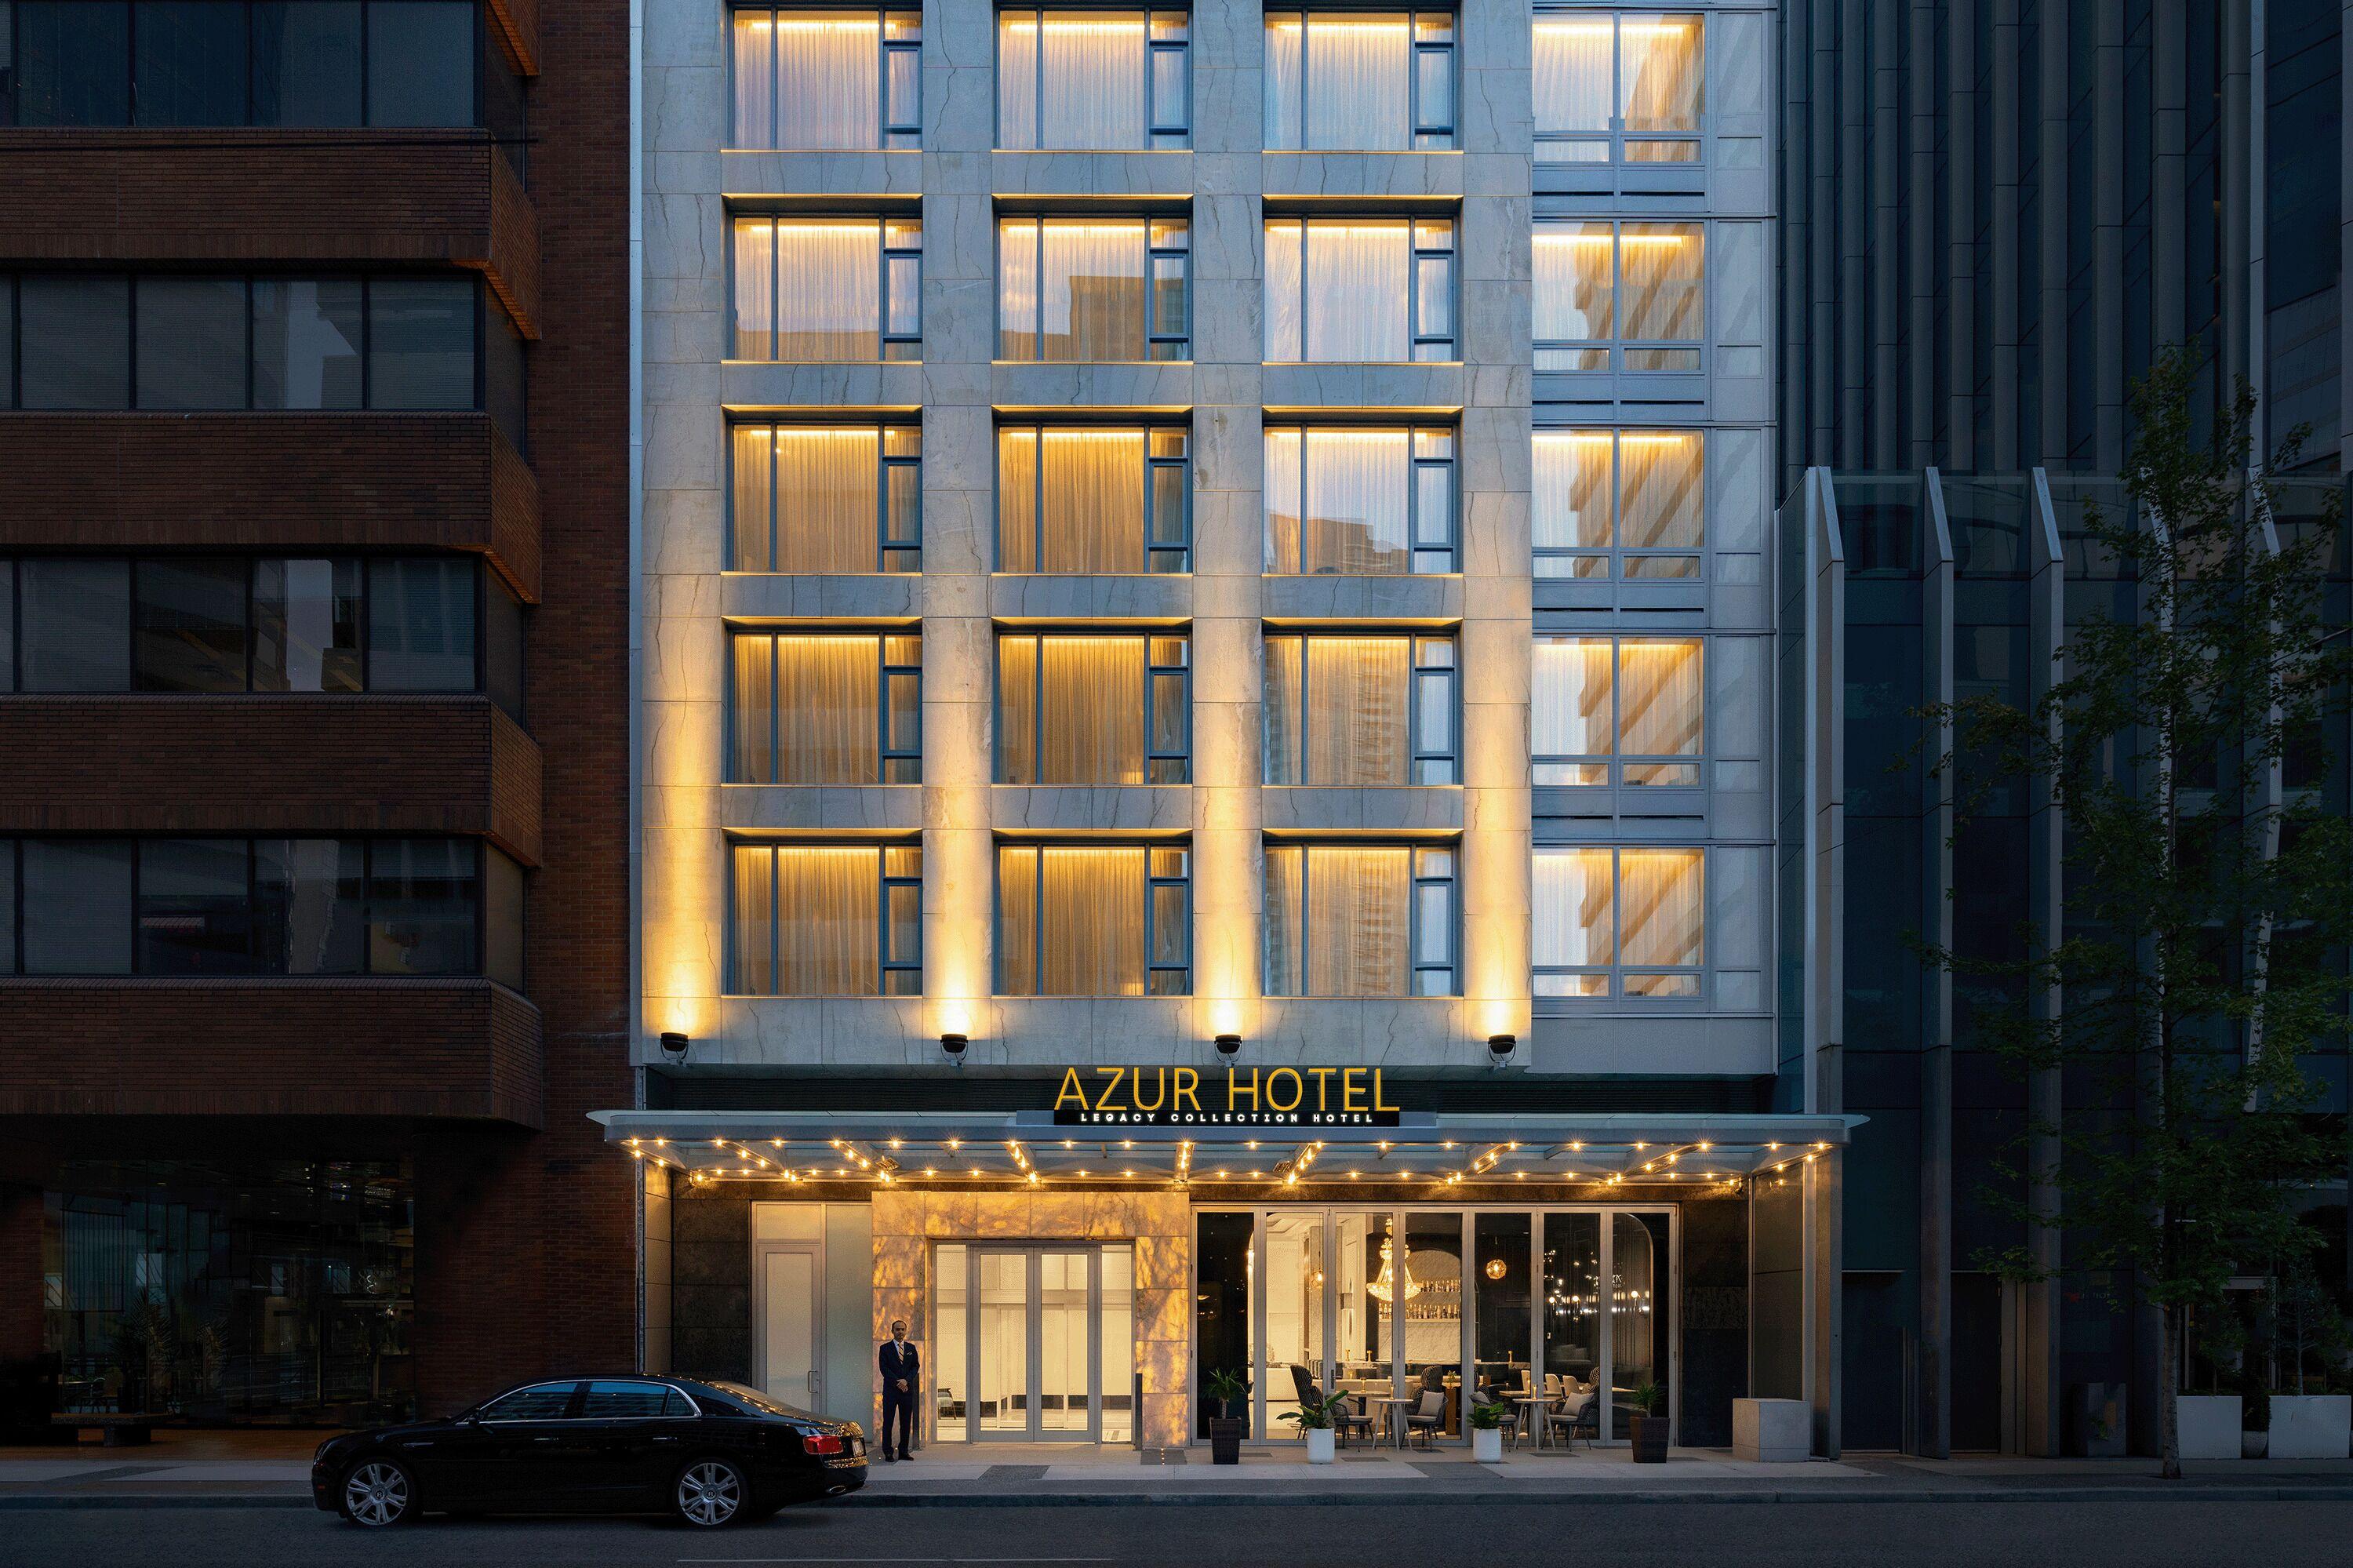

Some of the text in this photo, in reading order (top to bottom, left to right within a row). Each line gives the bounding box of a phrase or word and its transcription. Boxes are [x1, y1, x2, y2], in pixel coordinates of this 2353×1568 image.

[1054, 1067, 1400, 1111] AZUR HOTEL
[1080, 1113, 1373, 1122] LEGACY COLLECTION HOTEL
